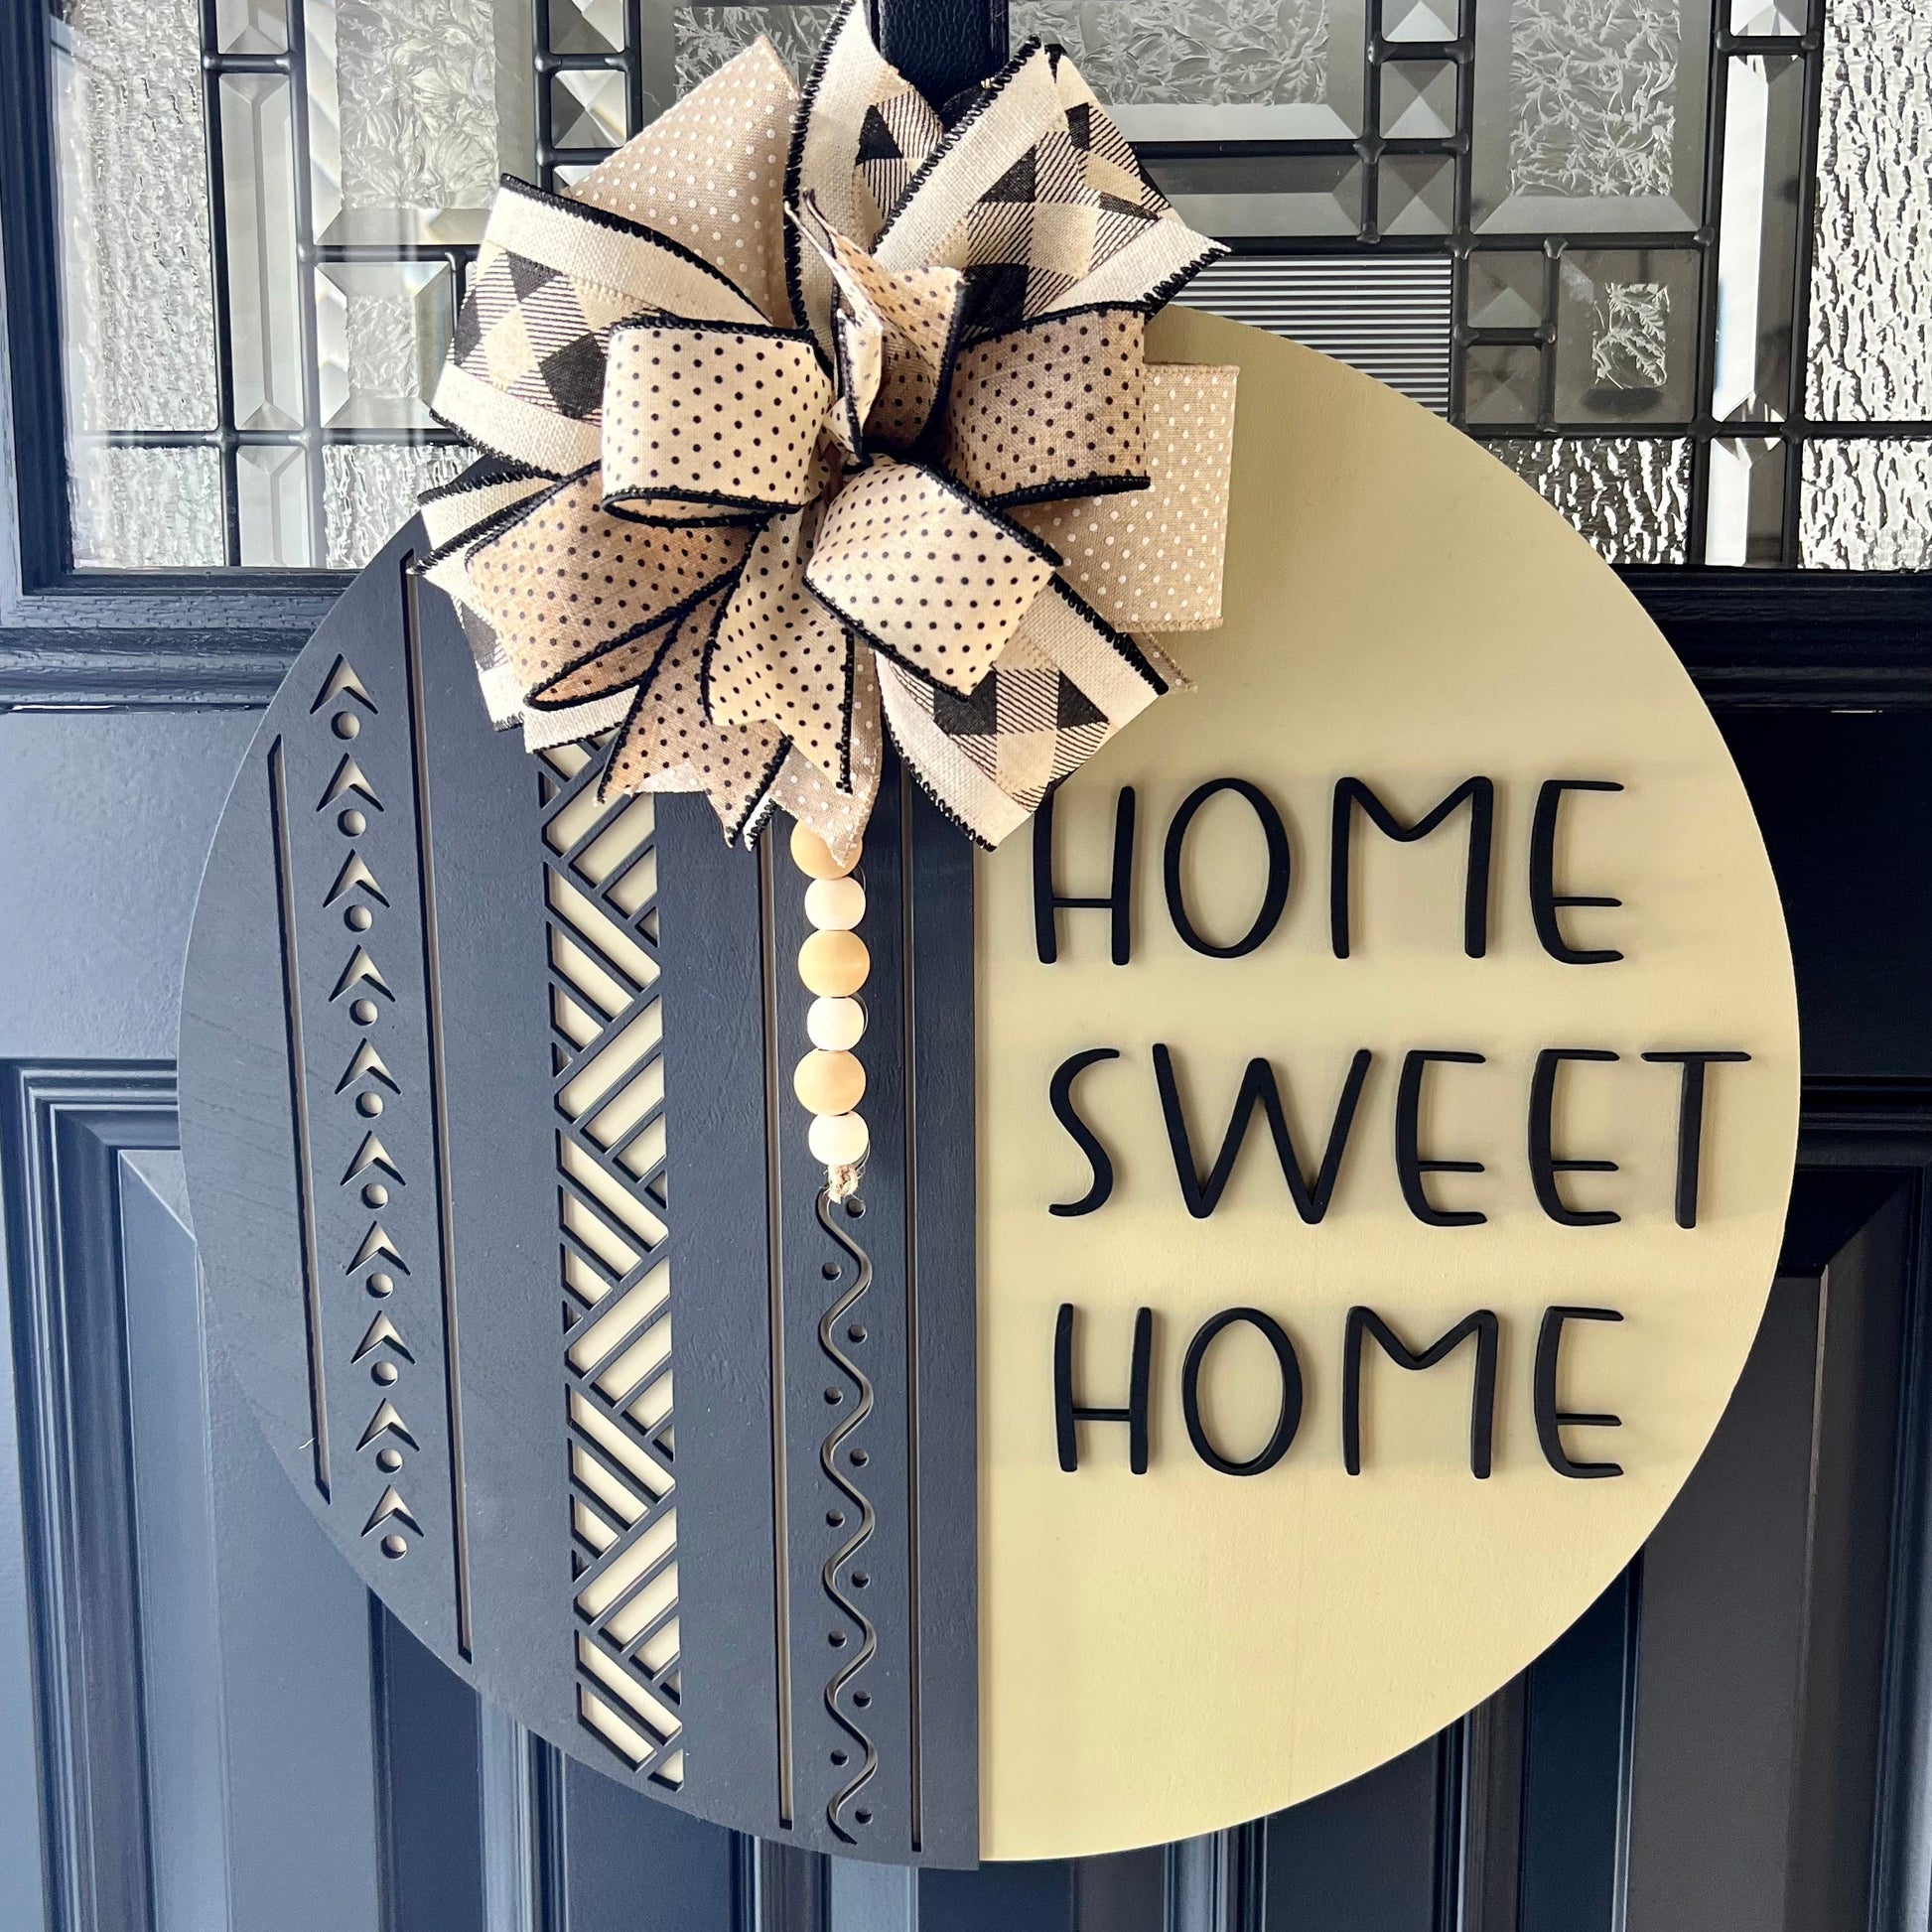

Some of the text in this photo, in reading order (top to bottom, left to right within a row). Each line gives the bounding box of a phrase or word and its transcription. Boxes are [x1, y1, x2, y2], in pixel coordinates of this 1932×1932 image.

[1033, 776, 1624, 966] HOME
[1048, 1042, 1752, 1229] SWEET
[1053, 1303, 1624, 1479] HOME
